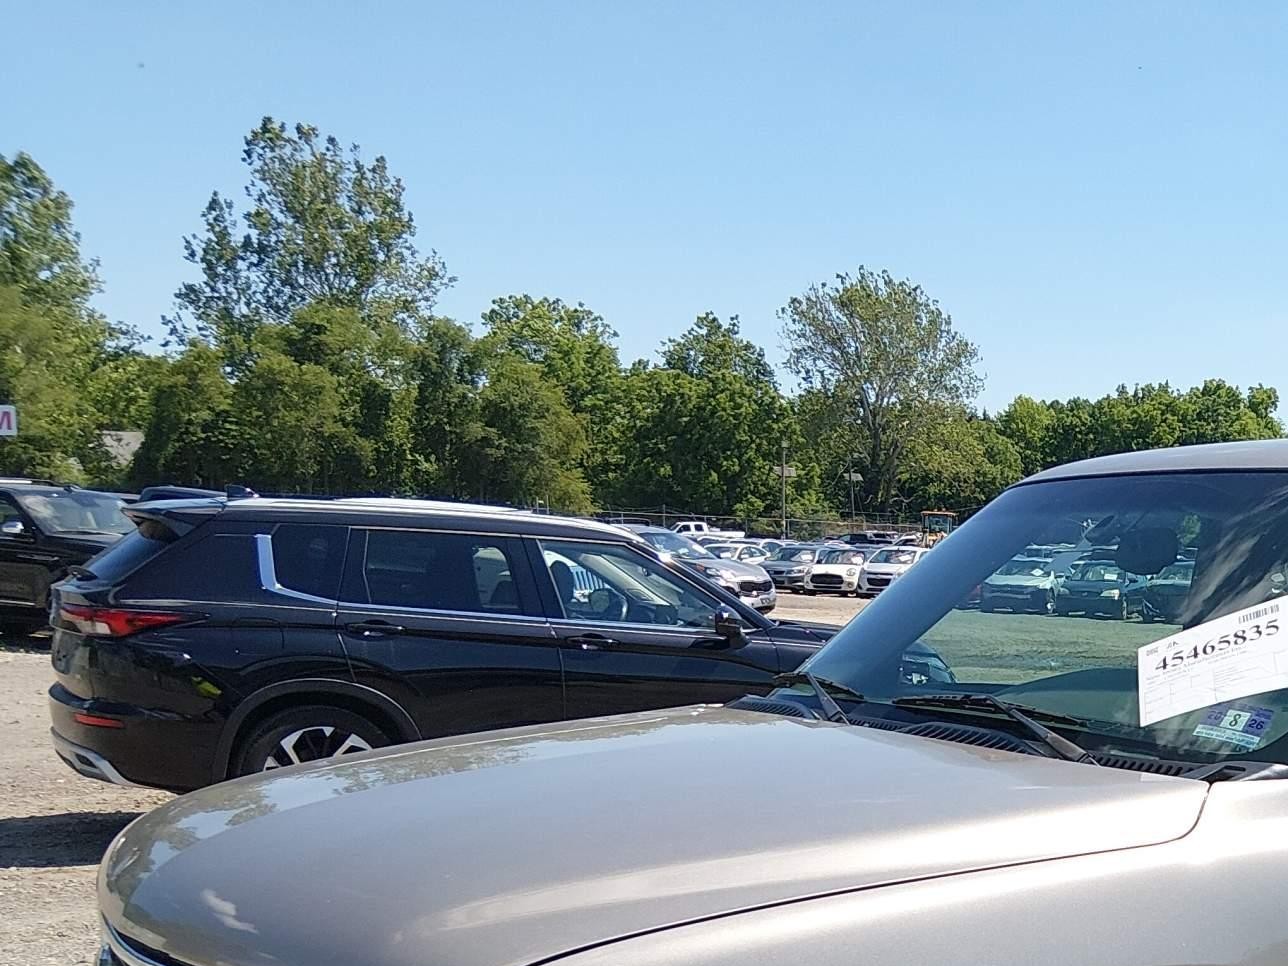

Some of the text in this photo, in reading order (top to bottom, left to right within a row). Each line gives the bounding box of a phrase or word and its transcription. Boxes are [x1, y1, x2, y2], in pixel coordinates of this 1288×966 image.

[1155, 618, 1280, 671] 45465835
[1229, 713, 1242, 727] 8
[1248, 718, 1265, 730] 26
